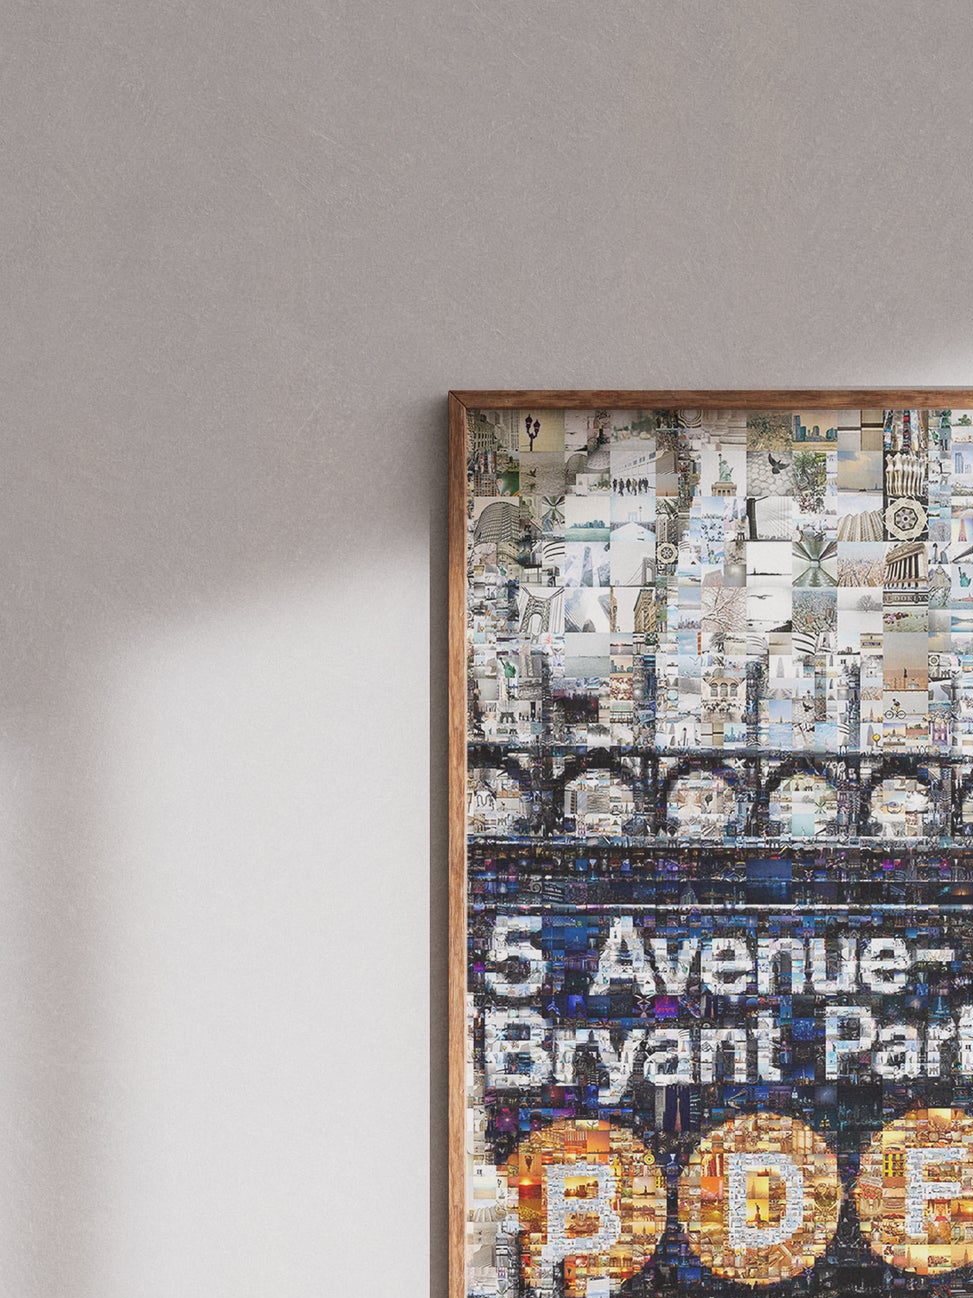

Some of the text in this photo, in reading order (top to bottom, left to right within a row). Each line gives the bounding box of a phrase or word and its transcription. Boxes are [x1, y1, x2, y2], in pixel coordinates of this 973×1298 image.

[482, 913, 956, 997] 5 Avenue-
[483, 1004, 783, 1105] Bryant
[545, 1162, 621, 1257] B
[728, 1152, 805, 1248] D
[905, 1147, 969, 1238] F
